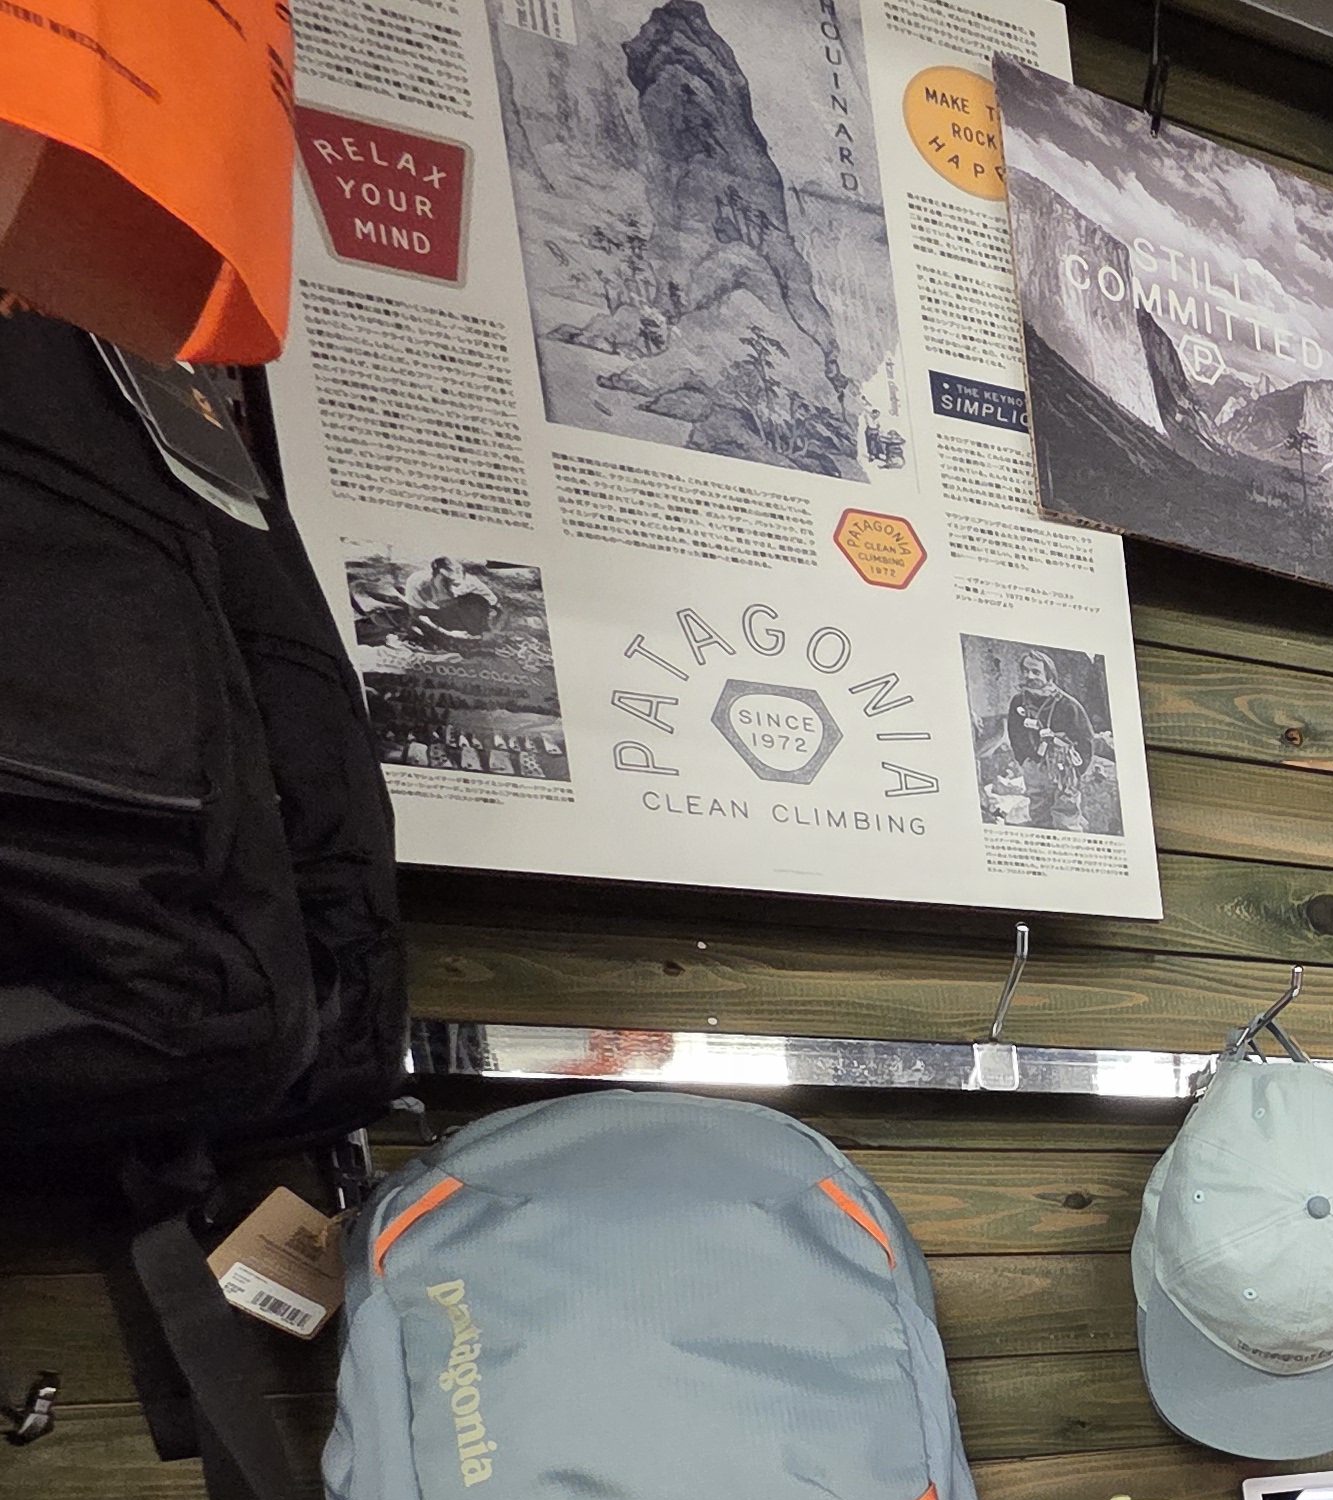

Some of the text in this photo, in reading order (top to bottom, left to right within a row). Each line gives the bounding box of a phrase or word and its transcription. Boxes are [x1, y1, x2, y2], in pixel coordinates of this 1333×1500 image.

[925, 87, 970, 114] MAKE
[952, 122, 997, 149] ROCK
[311, 137, 449, 190] RELAX
[336, 177, 435, 220] YOUR
[353, 217, 433, 256] MIND
[1134, 238, 1246, 304] STILL
[1066, 255, 1323, 370] COMMITTED
[956, 384, 979, 398] THE
[847, 520, 911, 555] PATAGONIA
[864, 541, 896, 554] CLEAN
[858, 552, 905, 567] CLIMBING
[611, 604, 940, 799] PATAGONIA
[737, 709, 817, 735] SINCE
[750, 730, 808, 755] 1972
[641, 791, 927, 837] CLEAN CLIMBING
[425, 1280, 497, 1489] patagonia
